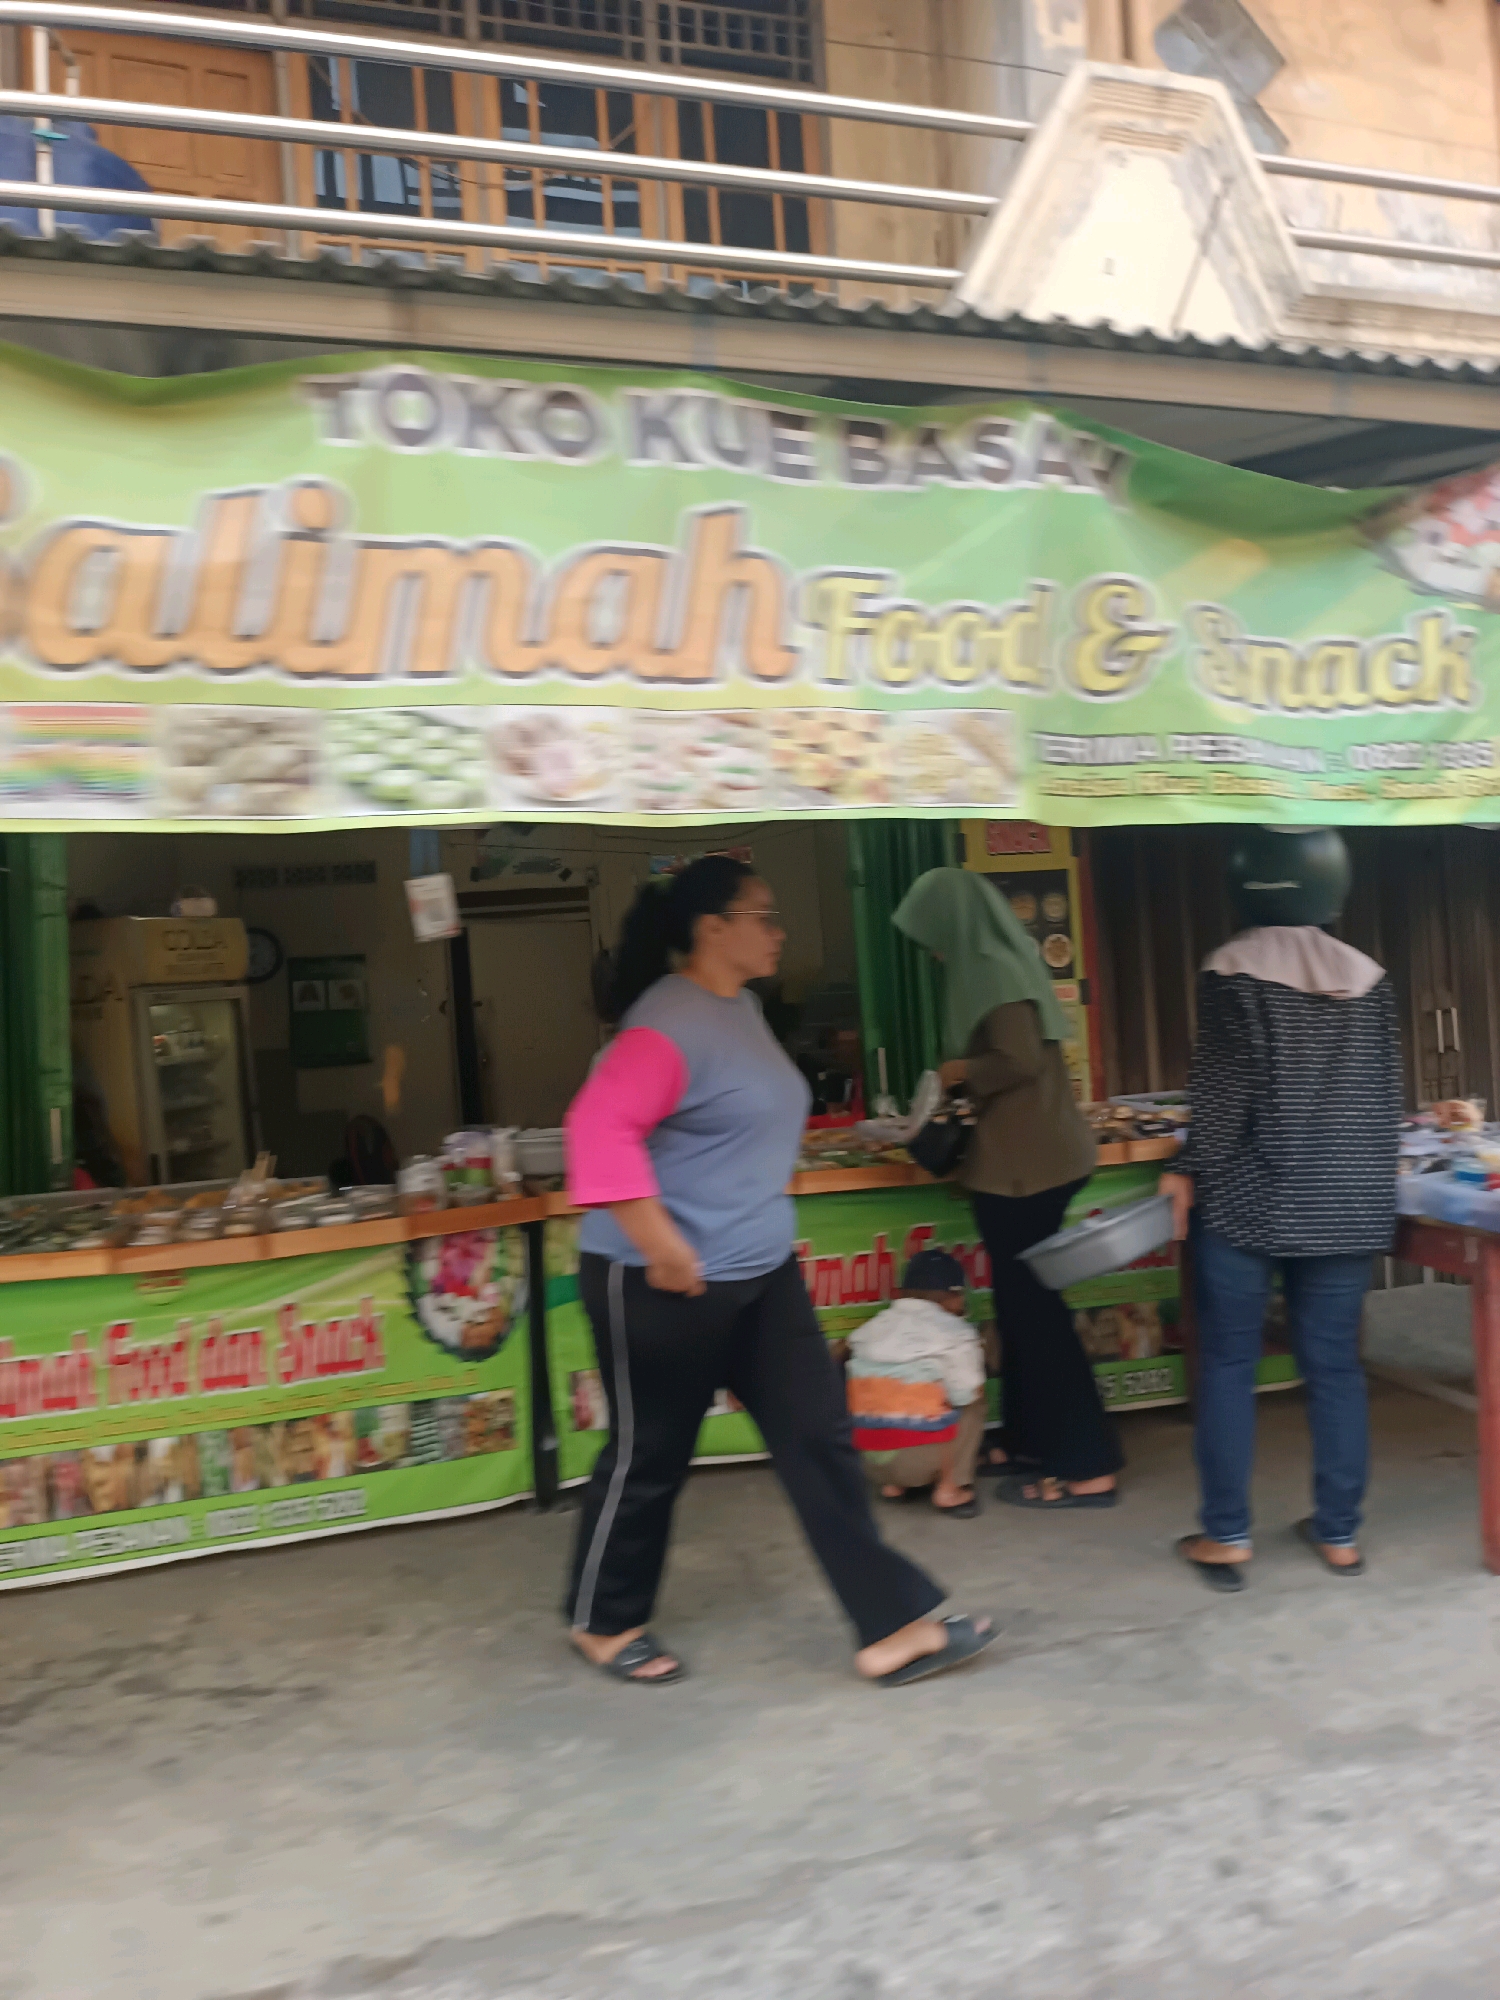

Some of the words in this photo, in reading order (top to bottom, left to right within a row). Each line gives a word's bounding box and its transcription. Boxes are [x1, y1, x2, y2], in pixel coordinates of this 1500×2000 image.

[300, 365, 600, 466] TOKO
[620, 387, 822, 488] KUE
[840, 412, 1147, 510] BASAH
[0, 452, 795, 686] alimah
[799, 567, 1057, 694] Food
[1061, 573, 1174, 701] &
[1191, 604, 1479, 715] Snack
[1168, 732, 1327, 774] PESANAN
[103, 1318, 193, 1408] Food
[199, 1314, 268, 1397] dan
[275, 1294, 386, 1389] Snack
